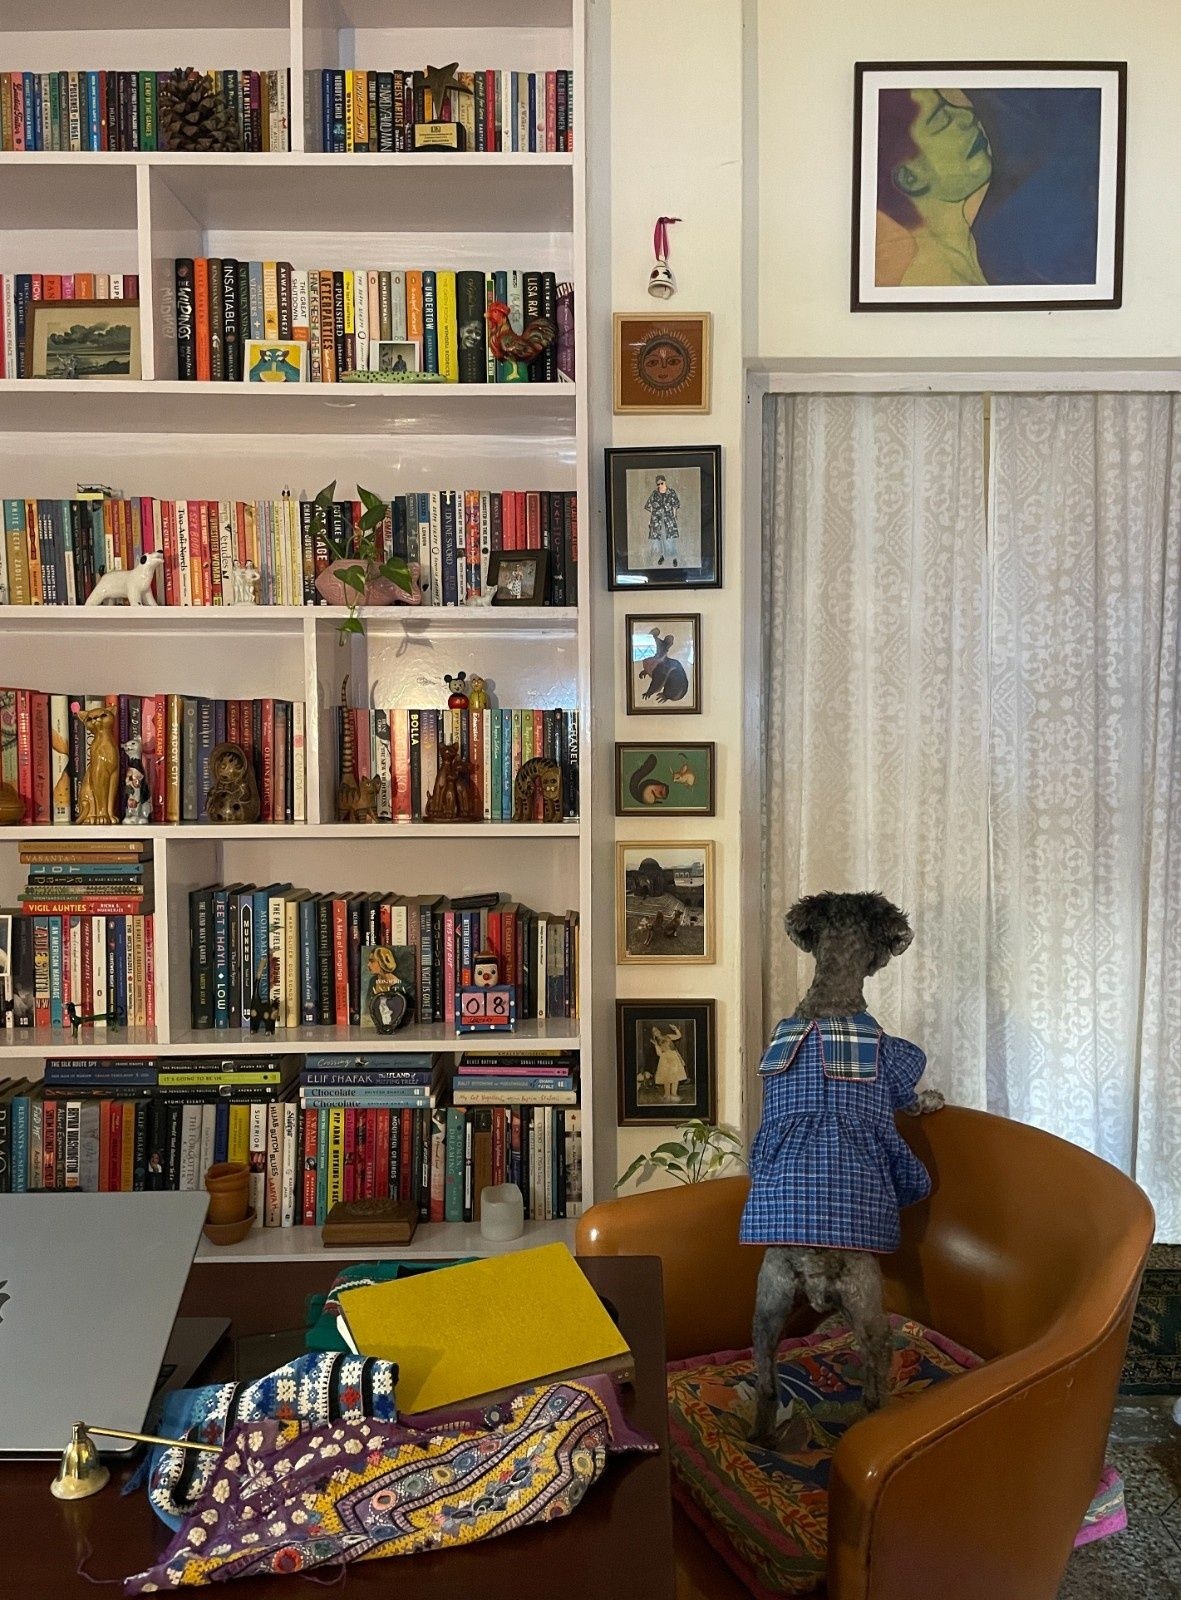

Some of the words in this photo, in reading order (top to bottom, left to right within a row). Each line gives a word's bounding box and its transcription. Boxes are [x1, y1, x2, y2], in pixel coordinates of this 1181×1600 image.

[394, 80, 403, 101] HEIST
[394, 102, 404, 128] ARTIST
[528, 277, 538, 296] LISA
[223, 266, 235, 333] INSATIABLE
[425, 286, 434, 330] UNDERTOW
[528, 301, 538, 317] RAY
[178, 287, 192, 340] WILDINGS
[321, 277, 333, 350] AFTERPARTIES
[335, 288, 343, 337] PUNISHED
[11, 501, 19, 525] WHITE
[190, 512, 198, 529] SEX
[190, 531, 199, 555] BOOK
[14, 559, 22, 581] ZADIE
[212, 553, 221, 585] WOMAN
[411, 713, 419, 746] BOLLA
[28, 904, 51, 912] VIGIL
[52, 904, 87, 912] AUNTIES
[216, 900, 225, 925] JEET
[52, 926, 59, 935] AN
[446, 919, 454, 935] THIS
[35, 926, 49, 957] ZADIE
[52, 936, 60, 967] AMERICAN
[217, 929, 225, 969] THAYIL
[35, 960, 49, 993] SMITH
[336, 950, 344, 981] Longings
[421, 966, 432, 985] NIGHT
[52, 968, 60, 999] MARRIAGE
[217, 983, 226, 1011] LOW
[422, 993, 432, 1008] GONE
[307, 1074, 328, 1083] ELIF
[331, 1074, 373, 1083] SHAFAK
[311, 1088, 356, 1097] Chocolate
[312, 1099, 361, 1108] Chocolate
[67, 1107, 79, 1129] BRYAN
[189, 1116, 197, 1131] THE
[270, 1106, 279, 1128] HIJAB
[333, 1112, 341, 1123] PIP
[269, 1128, 279, 1153] BUTCH
[333, 1125, 341, 1145] ADAM
[66, 1130, 79, 1173] WASHINGTON
[186, 1134, 197, 1185] FORGOTTEN
[391, 1150, 397, 1159] OF
[269, 1153, 279, 1177] BLUES
